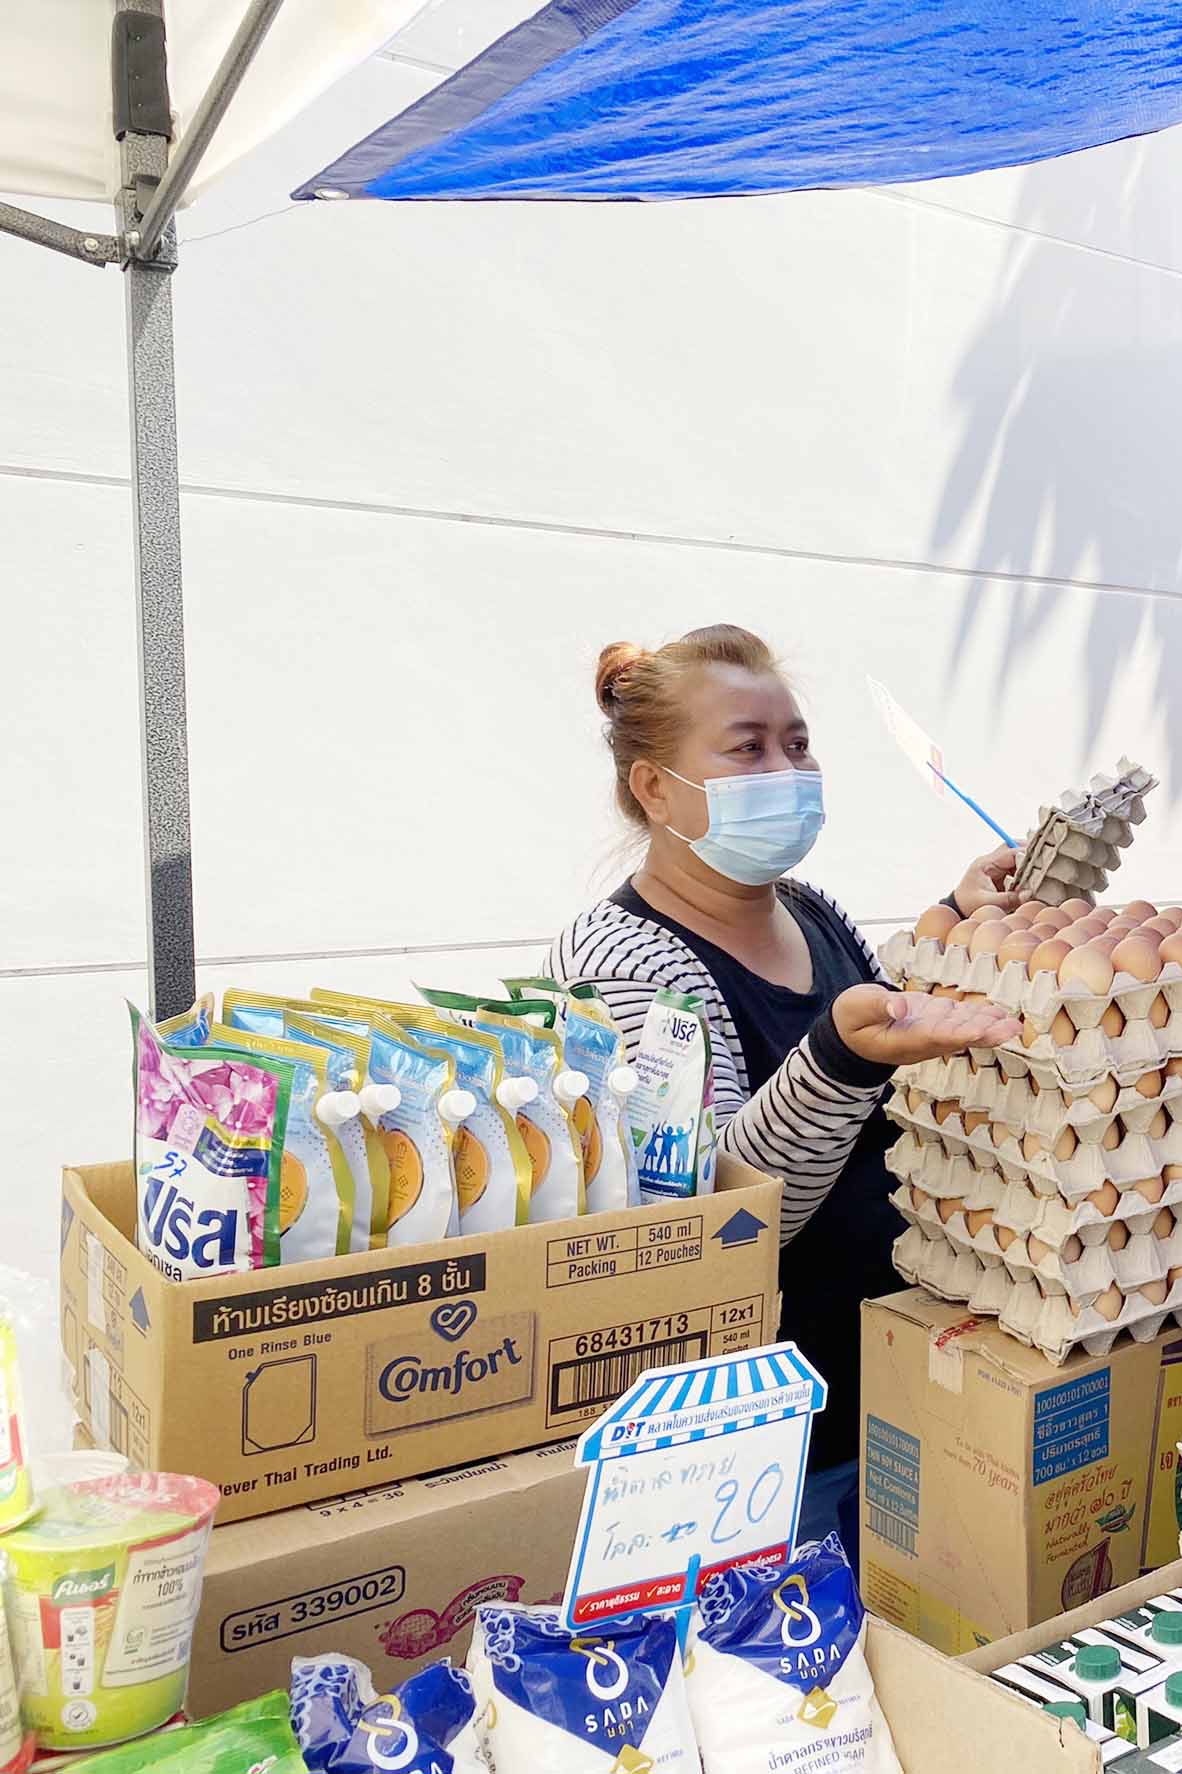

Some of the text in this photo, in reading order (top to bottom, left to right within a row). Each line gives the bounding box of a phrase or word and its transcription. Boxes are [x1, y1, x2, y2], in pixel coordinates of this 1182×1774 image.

[566, 1234, 620, 1258] NET WT.
[649, 1222, 692, 1242] 540 ml
[568, 1258, 617, 1279] Packing
[639, 1243, 700, 1266] 12 Pouches
[212, 1260, 471, 1335] ห้ามเรียงซ้อนเกิน 8 ชั้น
[719, 1304, 754, 1325] 12x1
[228, 1332, 332, 1361] One Rinse Blue
[576, 1314, 689, 1357] 68431713
[723, 1329, 750, 1344] 540 ml
[378, 1337, 522, 1402] Comfort
[578, 1407, 596, 1417] 188
[264, 1467, 297, 1487] Thai
[304, 1453, 360, 1478] Trading
[366, 1446, 393, 1463] Ltd.
[1035, 1463, 1053, 1483] 700
[1077, 1449, 1090, 1467] 12
[709, 1461, 784, 1544] 20
[157, 1577, 183, 1598] 100%
[232, 1612, 280, 1641] รหัส
[291, 1574, 396, 1623] 339002
[779, 1647, 841, 1674] SADA
[585, 1696, 648, 1733] SADA
